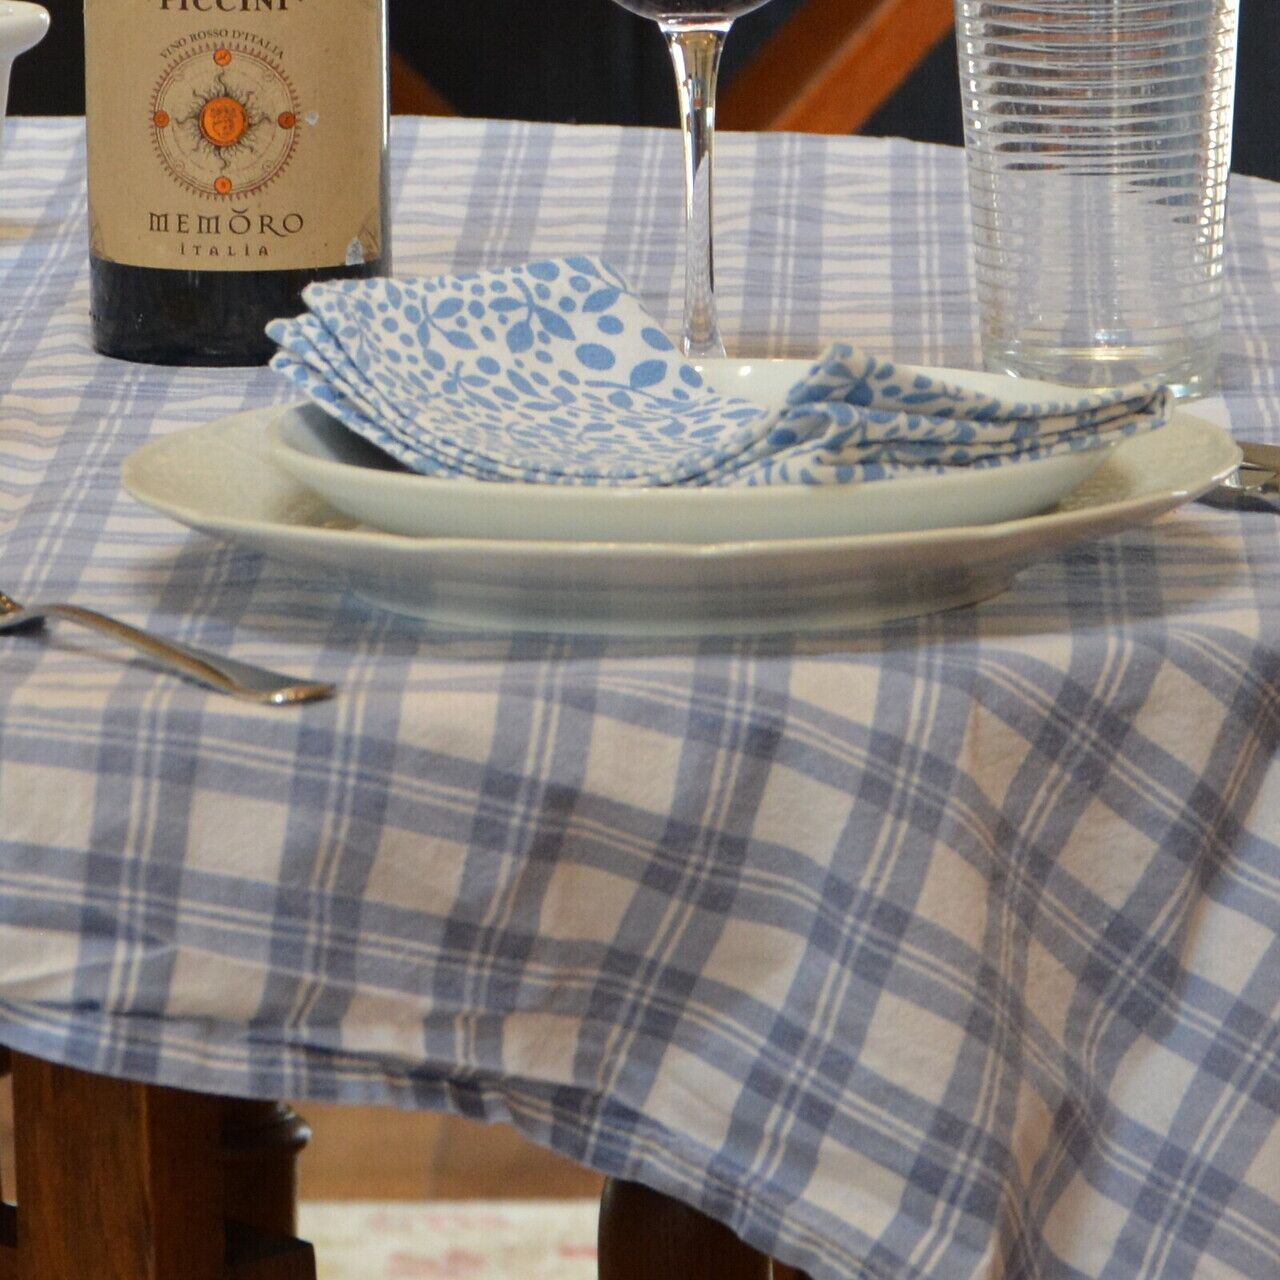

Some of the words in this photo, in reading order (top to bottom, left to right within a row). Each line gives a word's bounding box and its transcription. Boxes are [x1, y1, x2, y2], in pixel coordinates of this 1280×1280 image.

[160, 37, 187, 59] VINO
[189, 28, 229, 43] ROSSO
[232, 29, 284, 60] D'ITALIA
